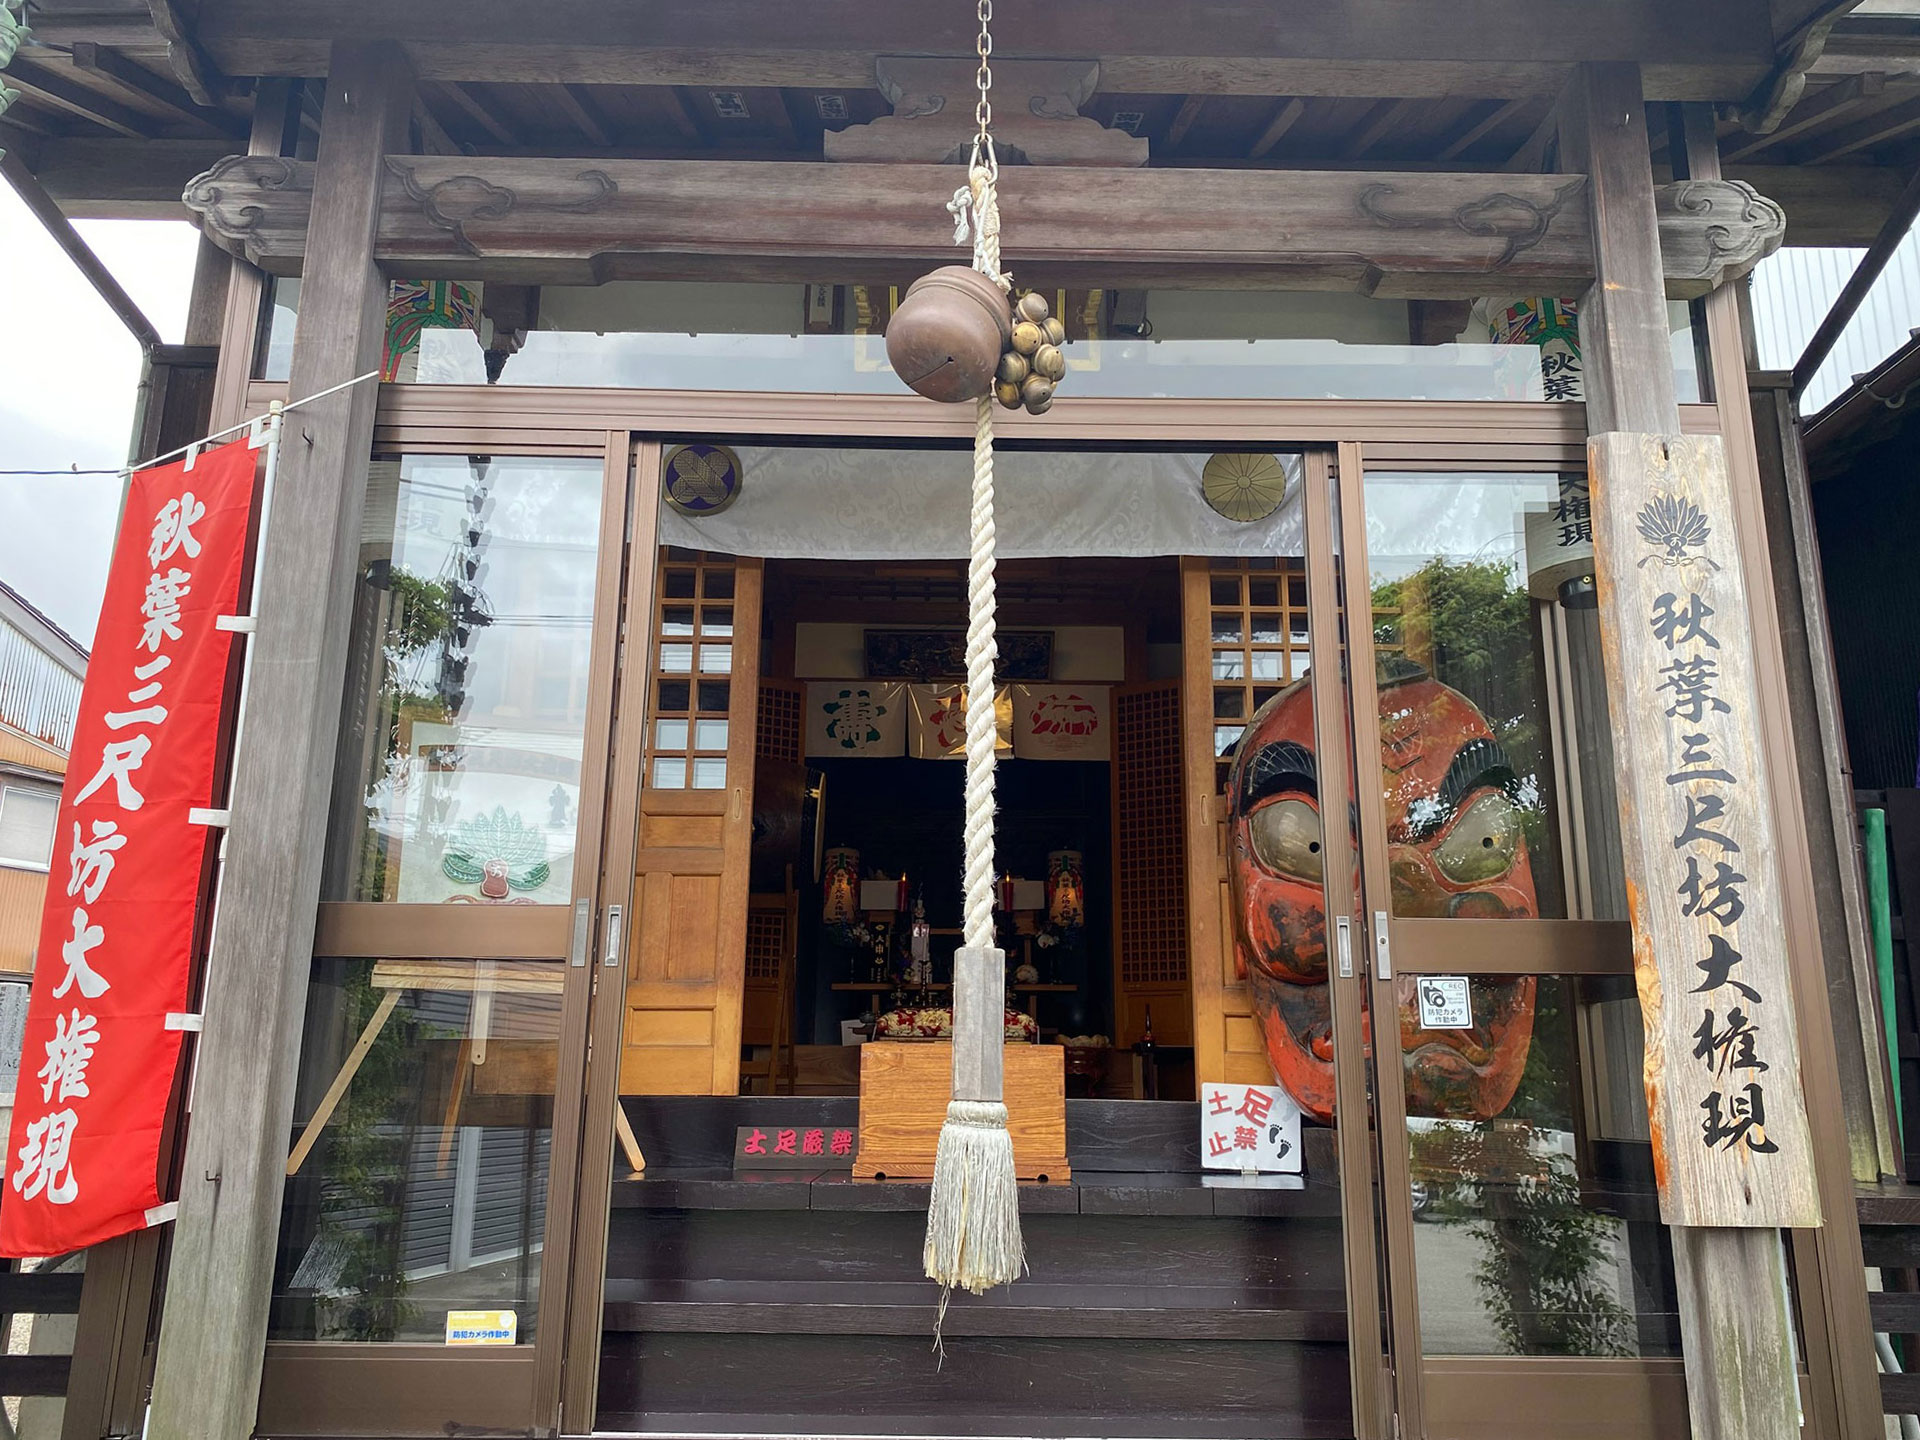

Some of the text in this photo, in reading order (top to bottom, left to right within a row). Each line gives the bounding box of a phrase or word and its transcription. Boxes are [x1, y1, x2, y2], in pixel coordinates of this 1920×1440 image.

[12, 491, 206, 1204] 秋葉三尺坊大権現
[1650, 591, 1779, 1153] 秋葉三尺坊大権現
[1428, 1008, 1463, 1016] 防犯カメラ
[452, 1330, 510, 1338] 防犯カメラ作動中
